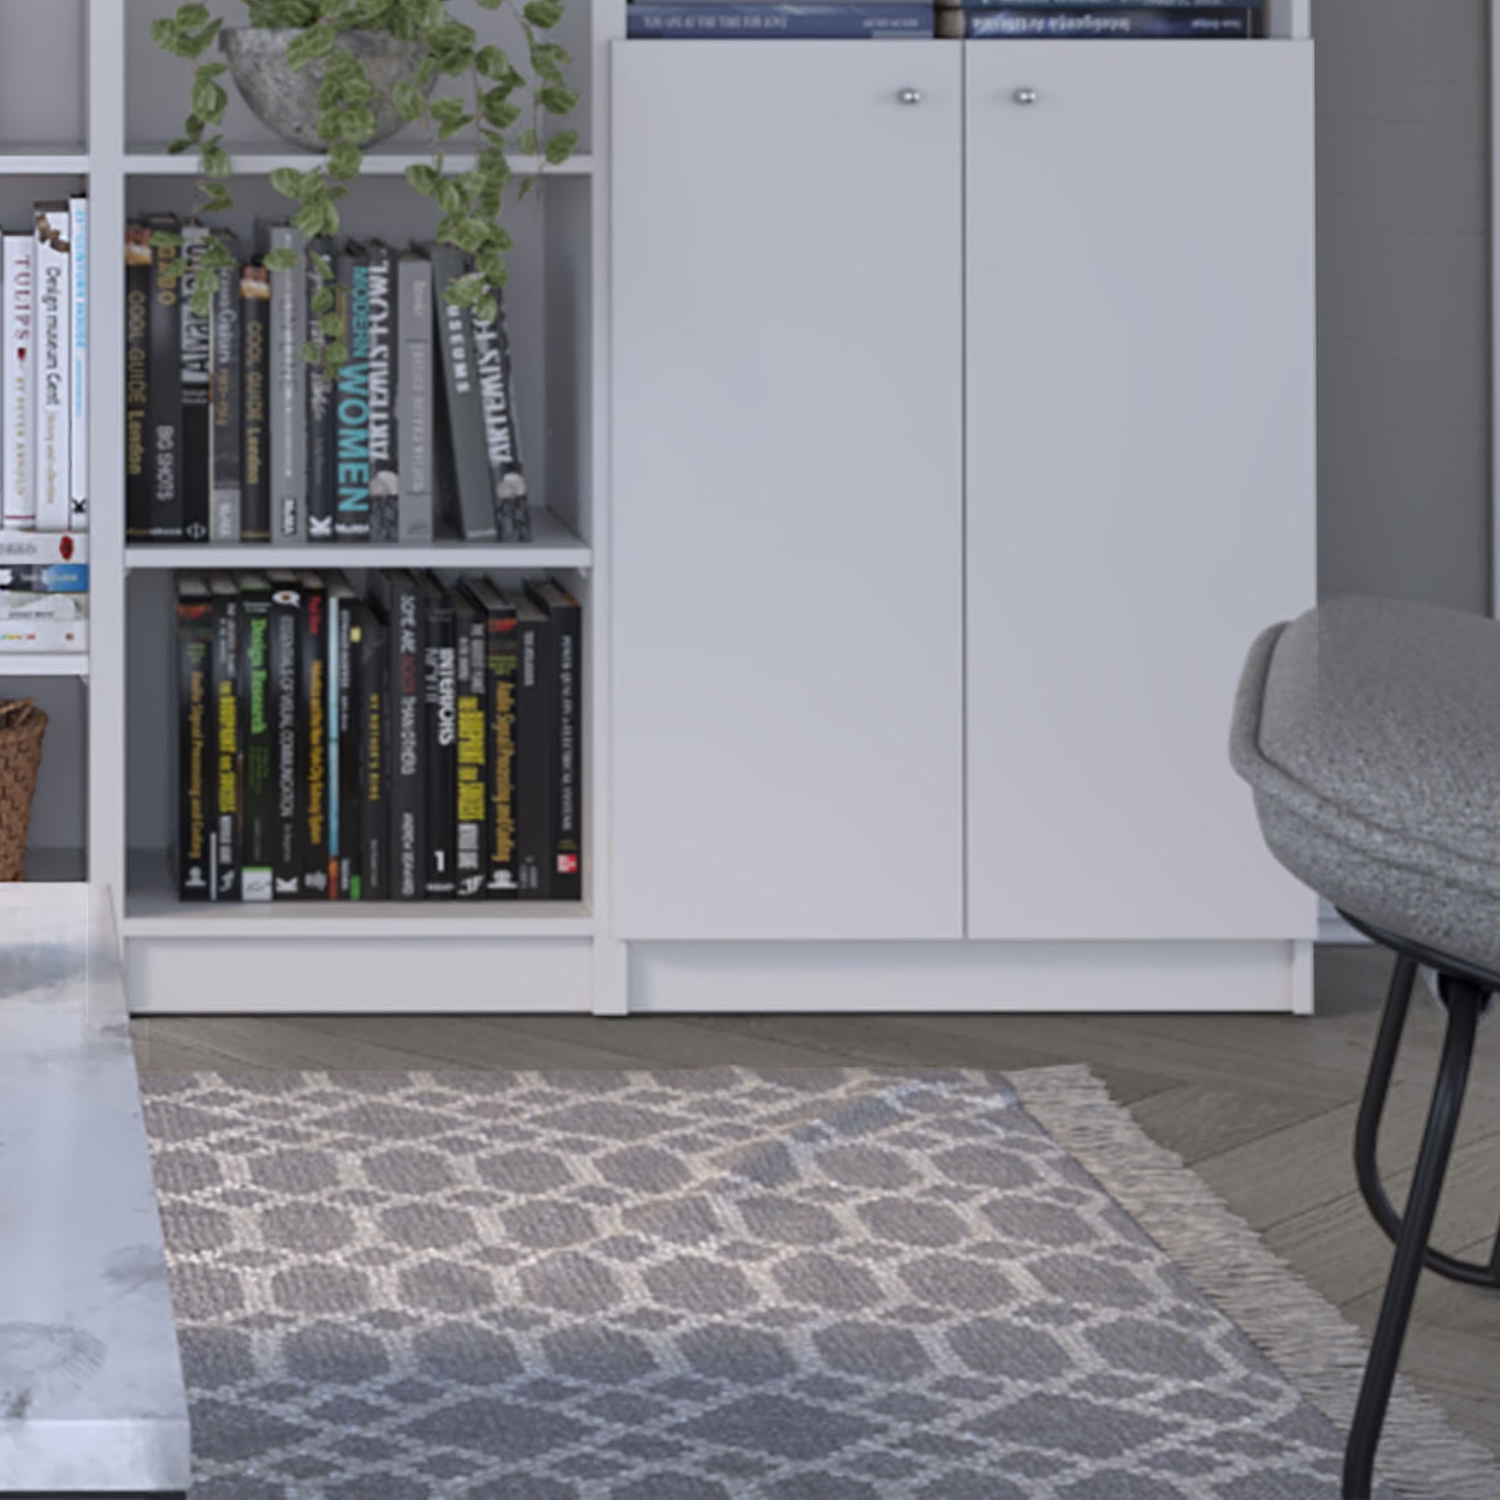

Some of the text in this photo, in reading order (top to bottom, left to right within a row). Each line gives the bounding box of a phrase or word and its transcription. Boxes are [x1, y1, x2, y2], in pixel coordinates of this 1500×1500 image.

[14, 255, 30, 339] TULIPS
[42, 266, 61, 311] Design
[352, 265, 369, 357] MODERN
[46, 315, 59, 368] museum
[368, 260, 389, 460] ARTEMIS FOWL
[129, 290, 147, 476] COOL GUIDE London
[246, 320, 262, 484] COOL GUIDE London
[475, 348, 514, 463] ARTEMIS
[156, 425, 175, 501] BIG SHOTS
[338, 364, 369, 512] WOMEN
[309, 515, 332, 536] K
[400, 594, 416, 628] SOME
[400, 629, 416, 653] ARE
[247, 619, 267, 734] Design Research
[439, 647, 455, 746] INTERIORS
[492, 680, 514, 712] Audio
[400, 696, 416, 729] THAN
[492, 714, 514, 747] Signal
[492, 748, 514, 802] Processing
[492, 825, 514, 862] Coding
